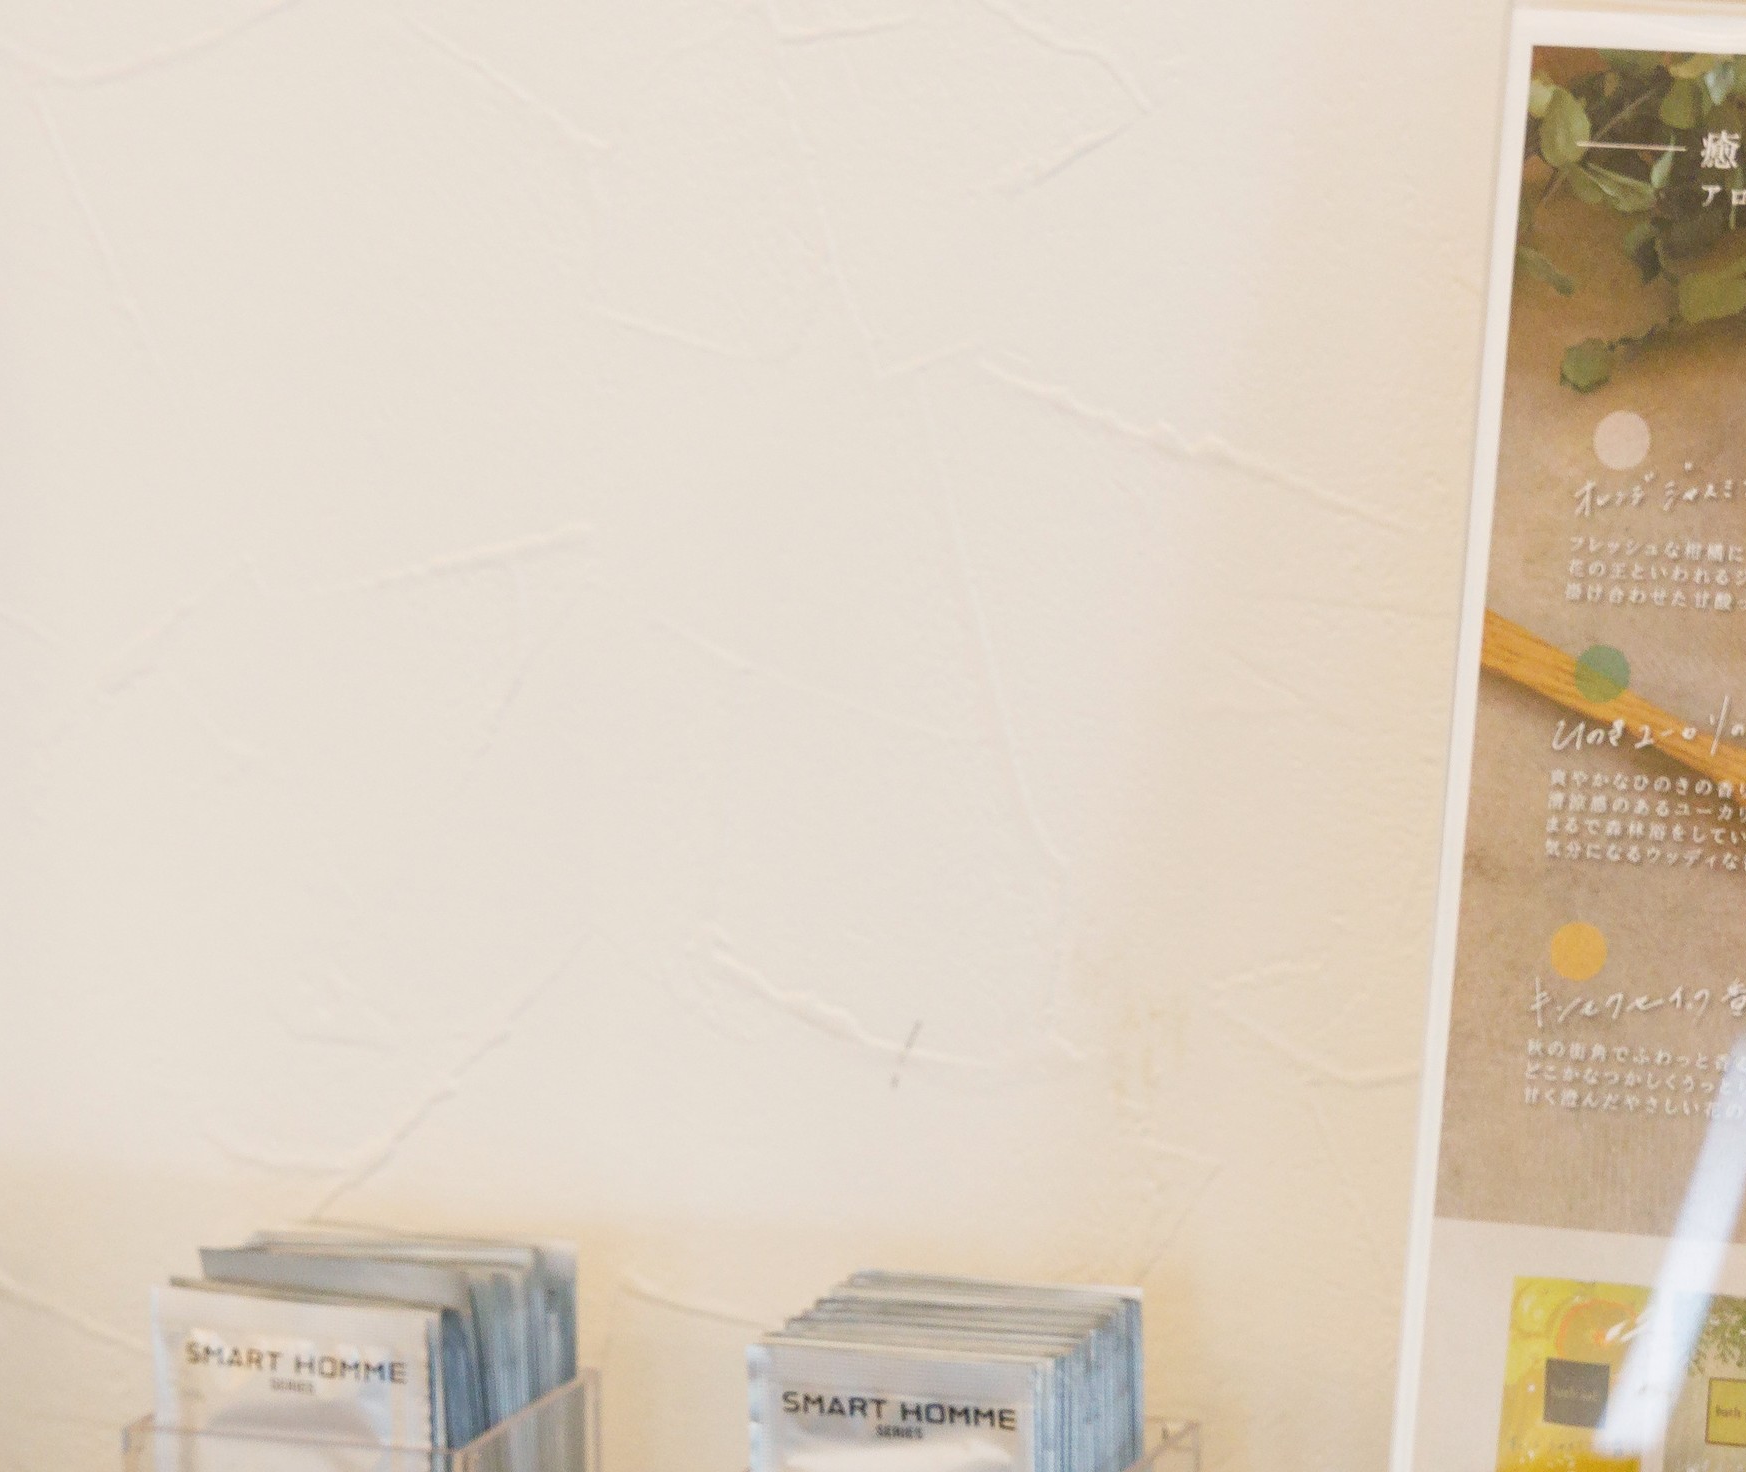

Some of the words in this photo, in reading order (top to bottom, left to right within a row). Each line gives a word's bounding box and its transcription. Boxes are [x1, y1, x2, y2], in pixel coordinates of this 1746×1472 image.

[185, 1340, 282, 1373] SMART
[295, 1351, 408, 1384] HOMME
[783, 1391, 887, 1422] SMART
[900, 1402, 1017, 1432] HOMME
[876, 1425, 923, 1442] SERIES
